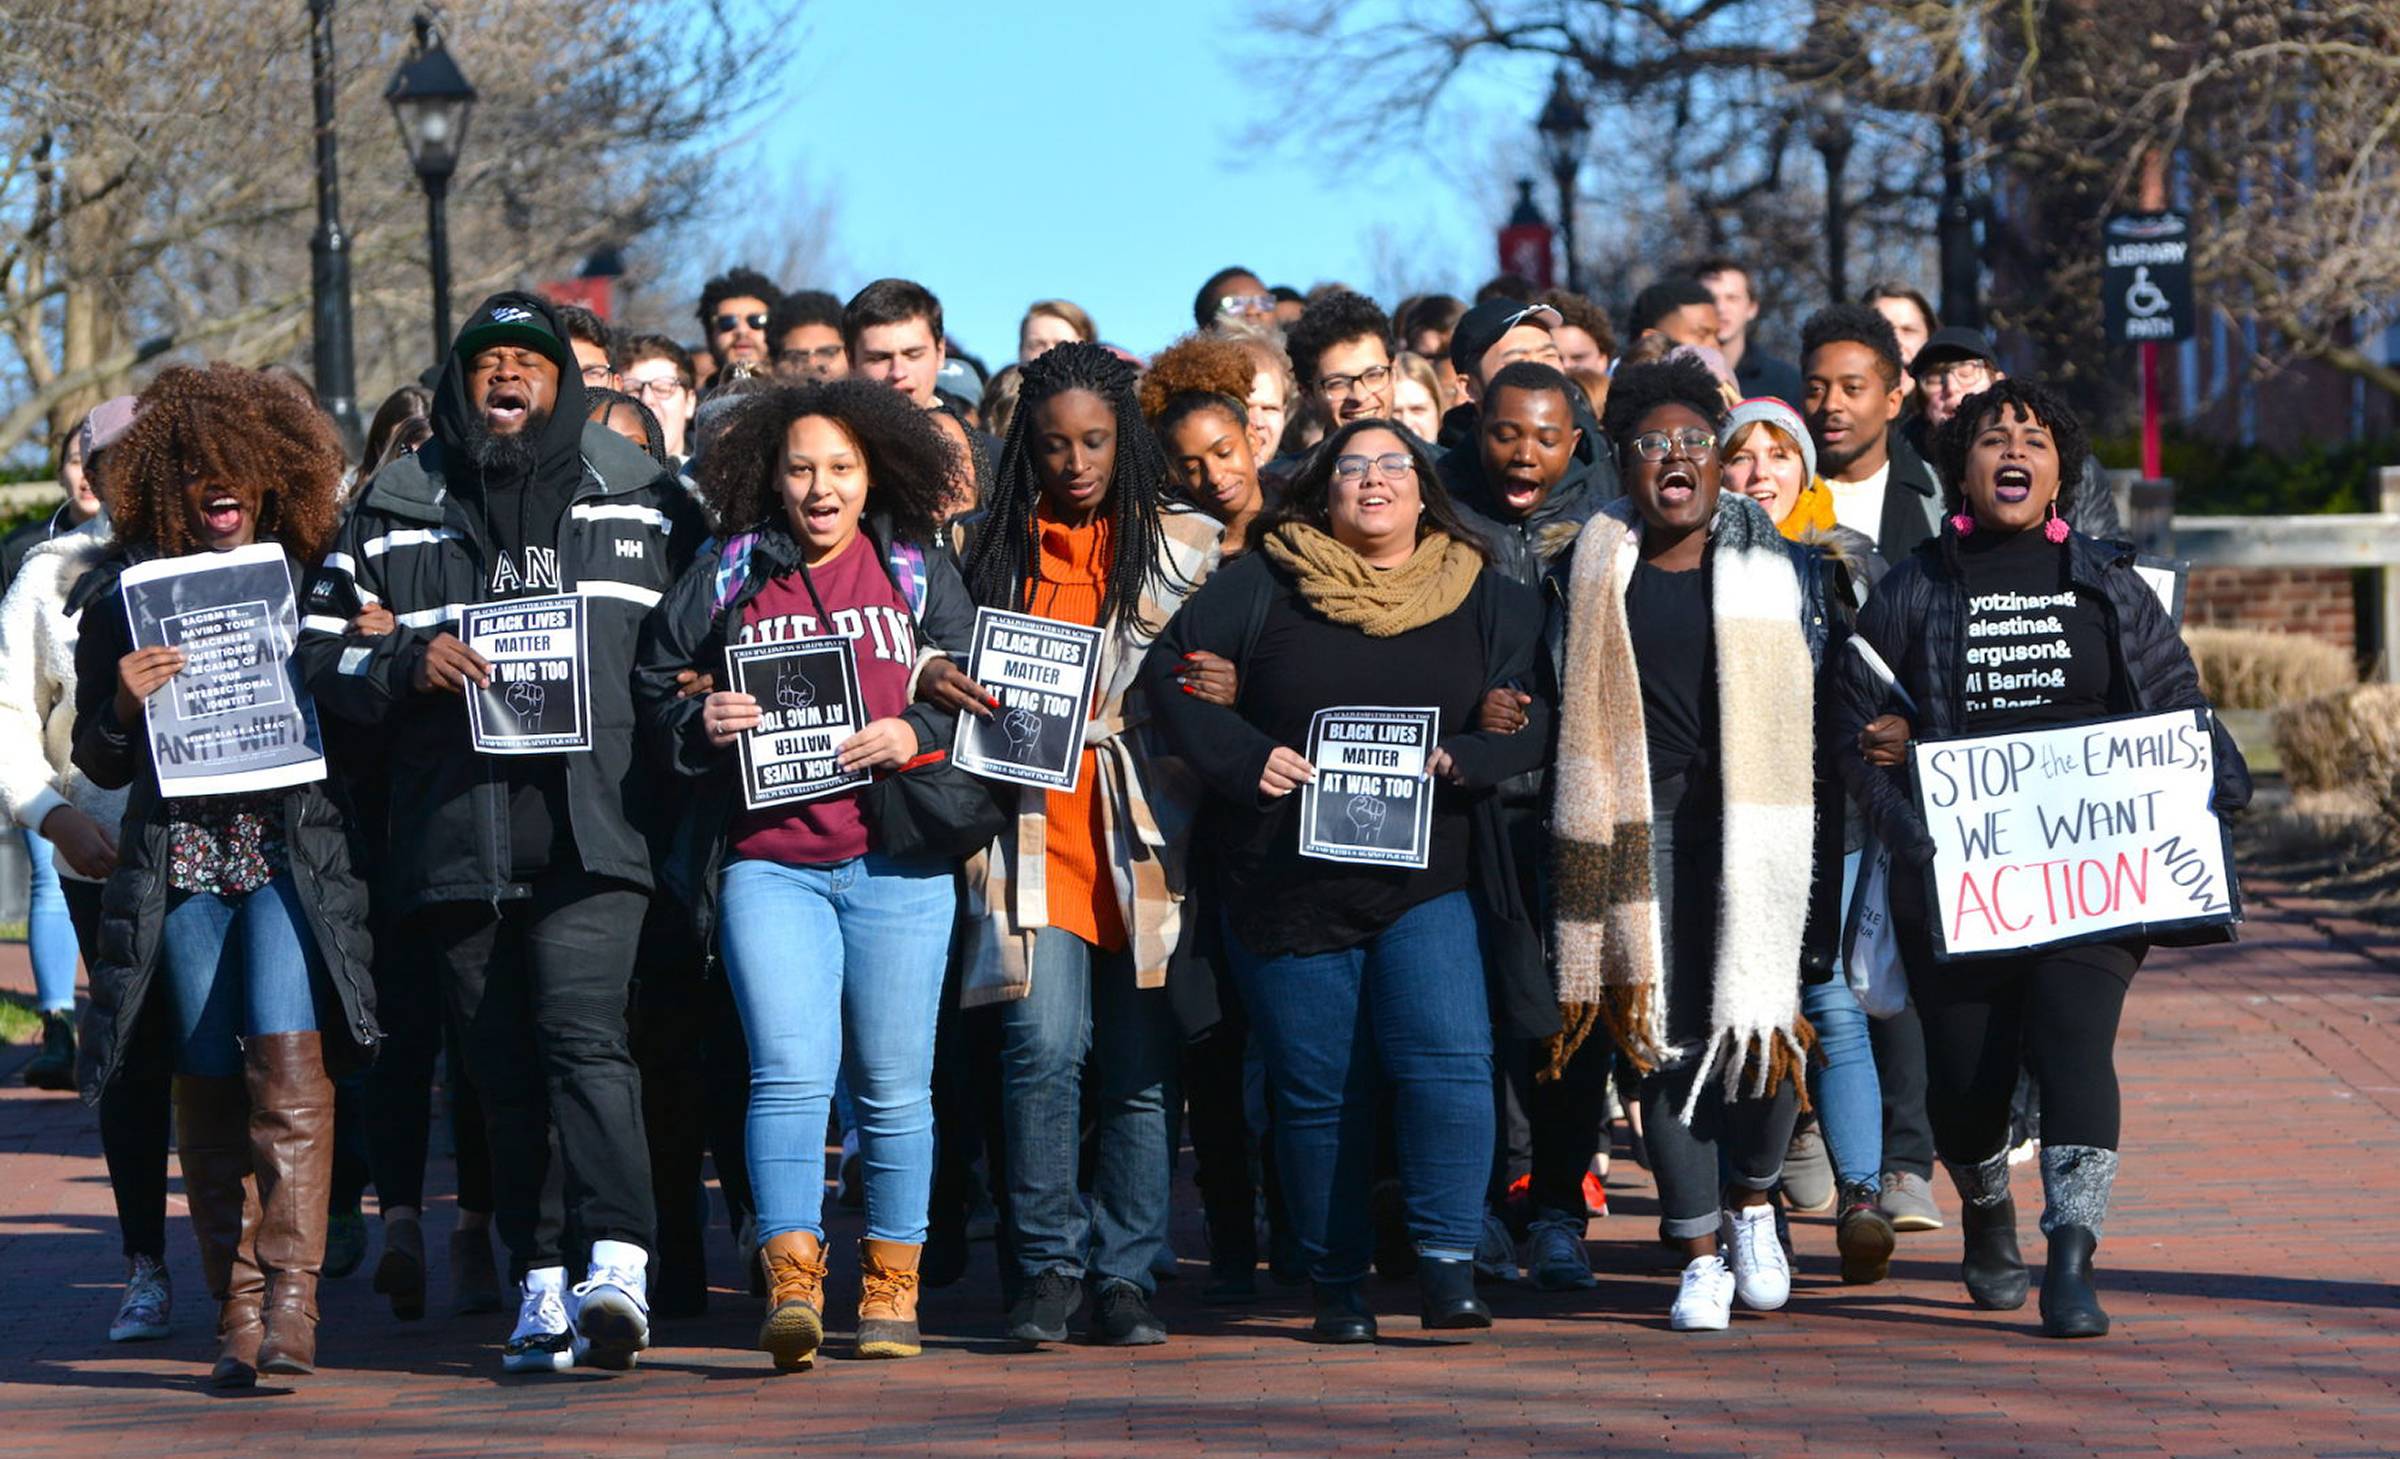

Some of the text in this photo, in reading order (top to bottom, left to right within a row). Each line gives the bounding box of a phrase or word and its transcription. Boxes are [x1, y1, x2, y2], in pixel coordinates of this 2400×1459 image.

[2107, 241, 2188, 267] LIBRARY
[2125, 317, 2174, 339] PATH
[614, 538, 644, 559] HH
[180, 619, 255, 639] HAVING YOUR
[181, 612, 224, 626] RACISM
[479, 611, 567, 635] BLACK LIVES
[1968, 615, 2064, 637] alestina&
[189, 632, 250, 650] BLACKNESS
[494, 635, 551, 653] MATTER
[992, 630, 1081, 663] BLACK LIVES
[188, 644, 256, 662] QUESTIONED
[1966, 639, 2073, 667] erguson&
[191, 656, 257, 675] BECAUSE OF
[501, 661, 537, 682] WAC
[538, 661, 569, 681] TOO
[1003, 660, 1061, 685] MATTER
[211, 671, 242, 683] YOUR
[1987, 668, 2065, 691] Barrio&
[183, 679, 273, 701] INTERSECTIONAL
[206, 694, 254, 709] IDENTITY
[1005, 687, 1041, 711] WAC
[1042, 695, 1072, 717] TOO
[787, 706, 823, 728] WAC
[826, 704, 844, 723] AT
[1328, 723, 1418, 743] BLACK LIVES
[774, 734, 832, 756] MATTER
[1342, 747, 1399, 767] MATTER
[1930, 725, 2208, 807] STOP the EMAILS;
[764, 763, 802, 785] LIVES
[1322, 773, 1414, 798] AT WAC TOO
[1956, 790, 2164, 862] WE WANT
[2153, 836, 2230, 912] NOW
[1953, 847, 2149, 941] ACTION
